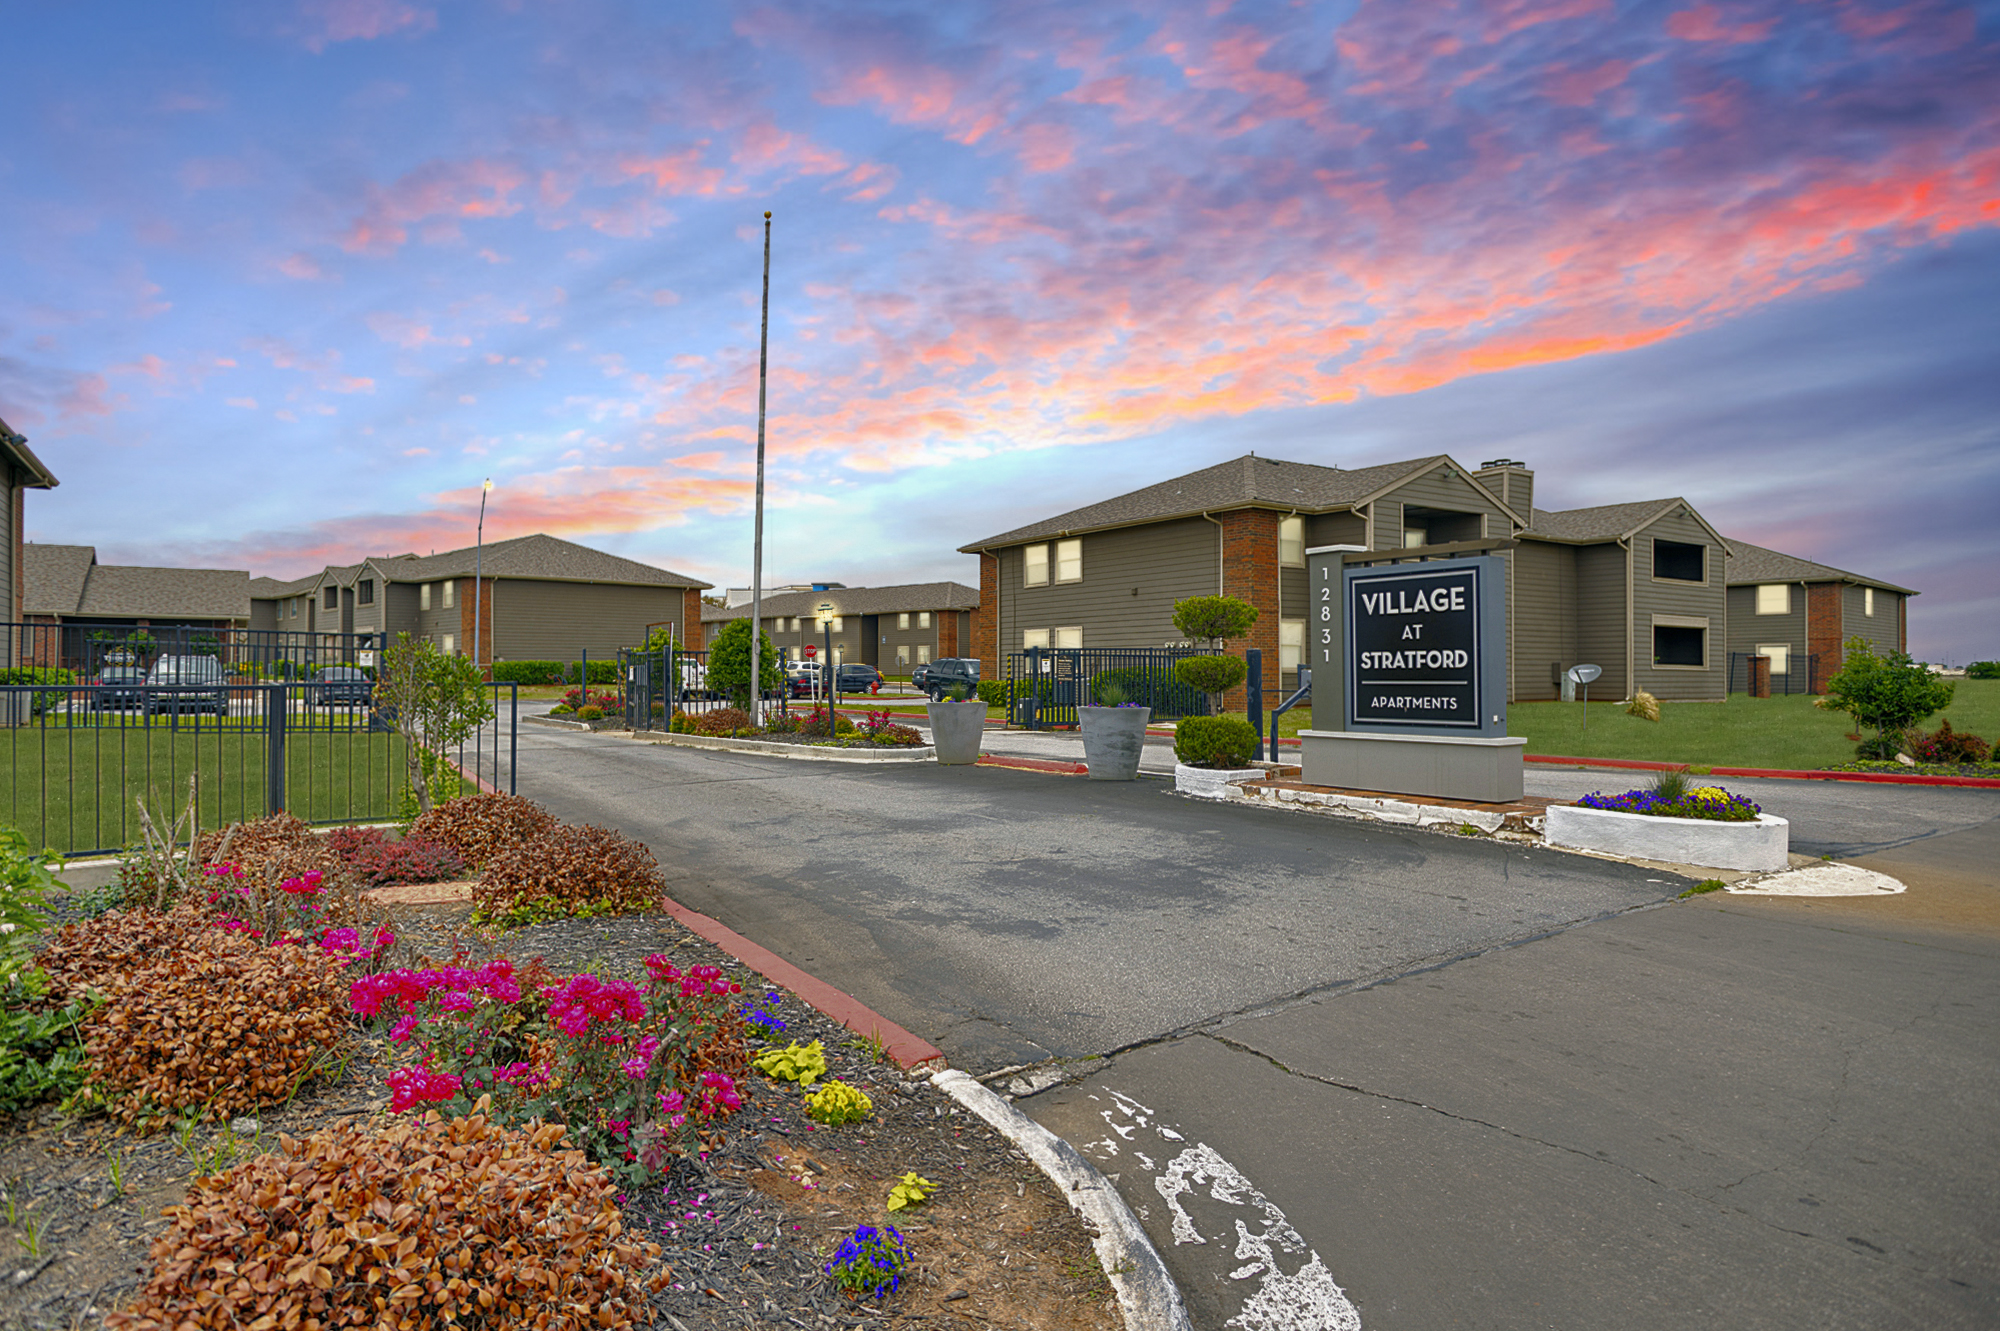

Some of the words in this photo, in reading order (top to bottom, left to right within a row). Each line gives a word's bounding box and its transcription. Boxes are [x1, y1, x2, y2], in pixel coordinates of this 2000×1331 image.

[1361, 586, 1465, 616] VILLAGE
[1321, 567, 1331, 662] 12831
[1401, 624, 1423, 640] AT
[1360, 649, 1468, 669] STRATFORD
[1371, 696, 1458, 710] APARTMENTS
